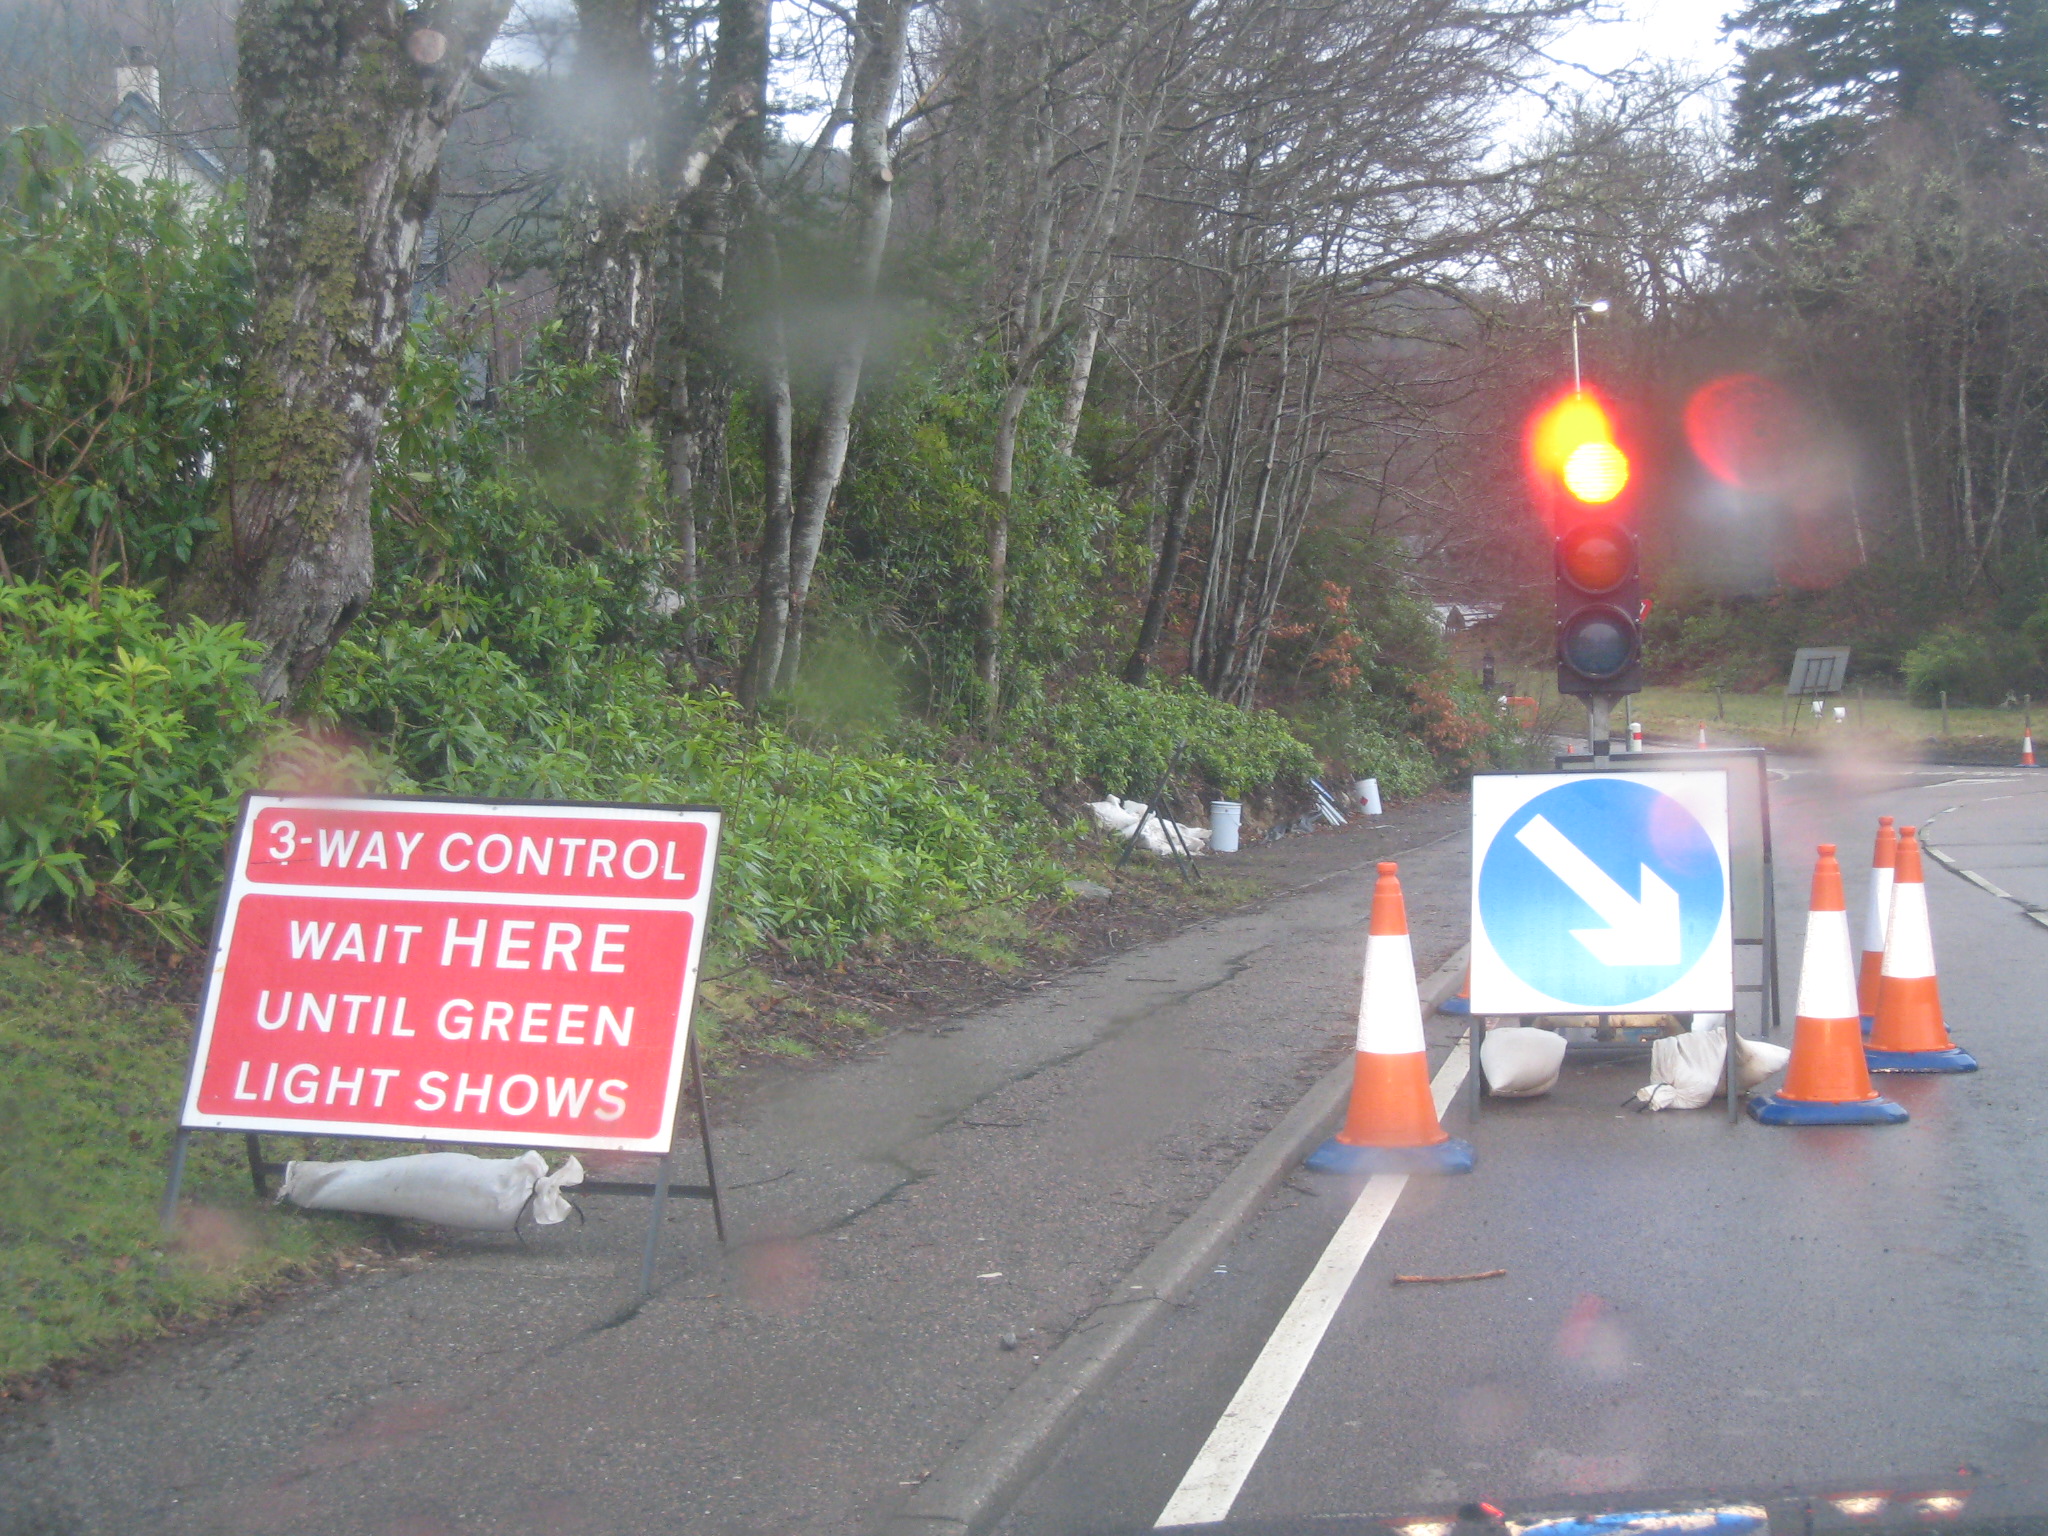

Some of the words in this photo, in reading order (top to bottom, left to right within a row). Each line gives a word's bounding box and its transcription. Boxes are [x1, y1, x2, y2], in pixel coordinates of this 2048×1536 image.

[269, 820, 424, 870] 3-WAY
[439, 831, 686, 881] CONTROL
[290, 920, 422, 963] WAIT
[441, 918, 630, 973] HERE
[256, 990, 415, 1037] UNTIL
[437, 999, 634, 1046] GREEN
[235, 1061, 400, 1107] LIGHT
[416, 1070, 629, 1122] SHOWS
